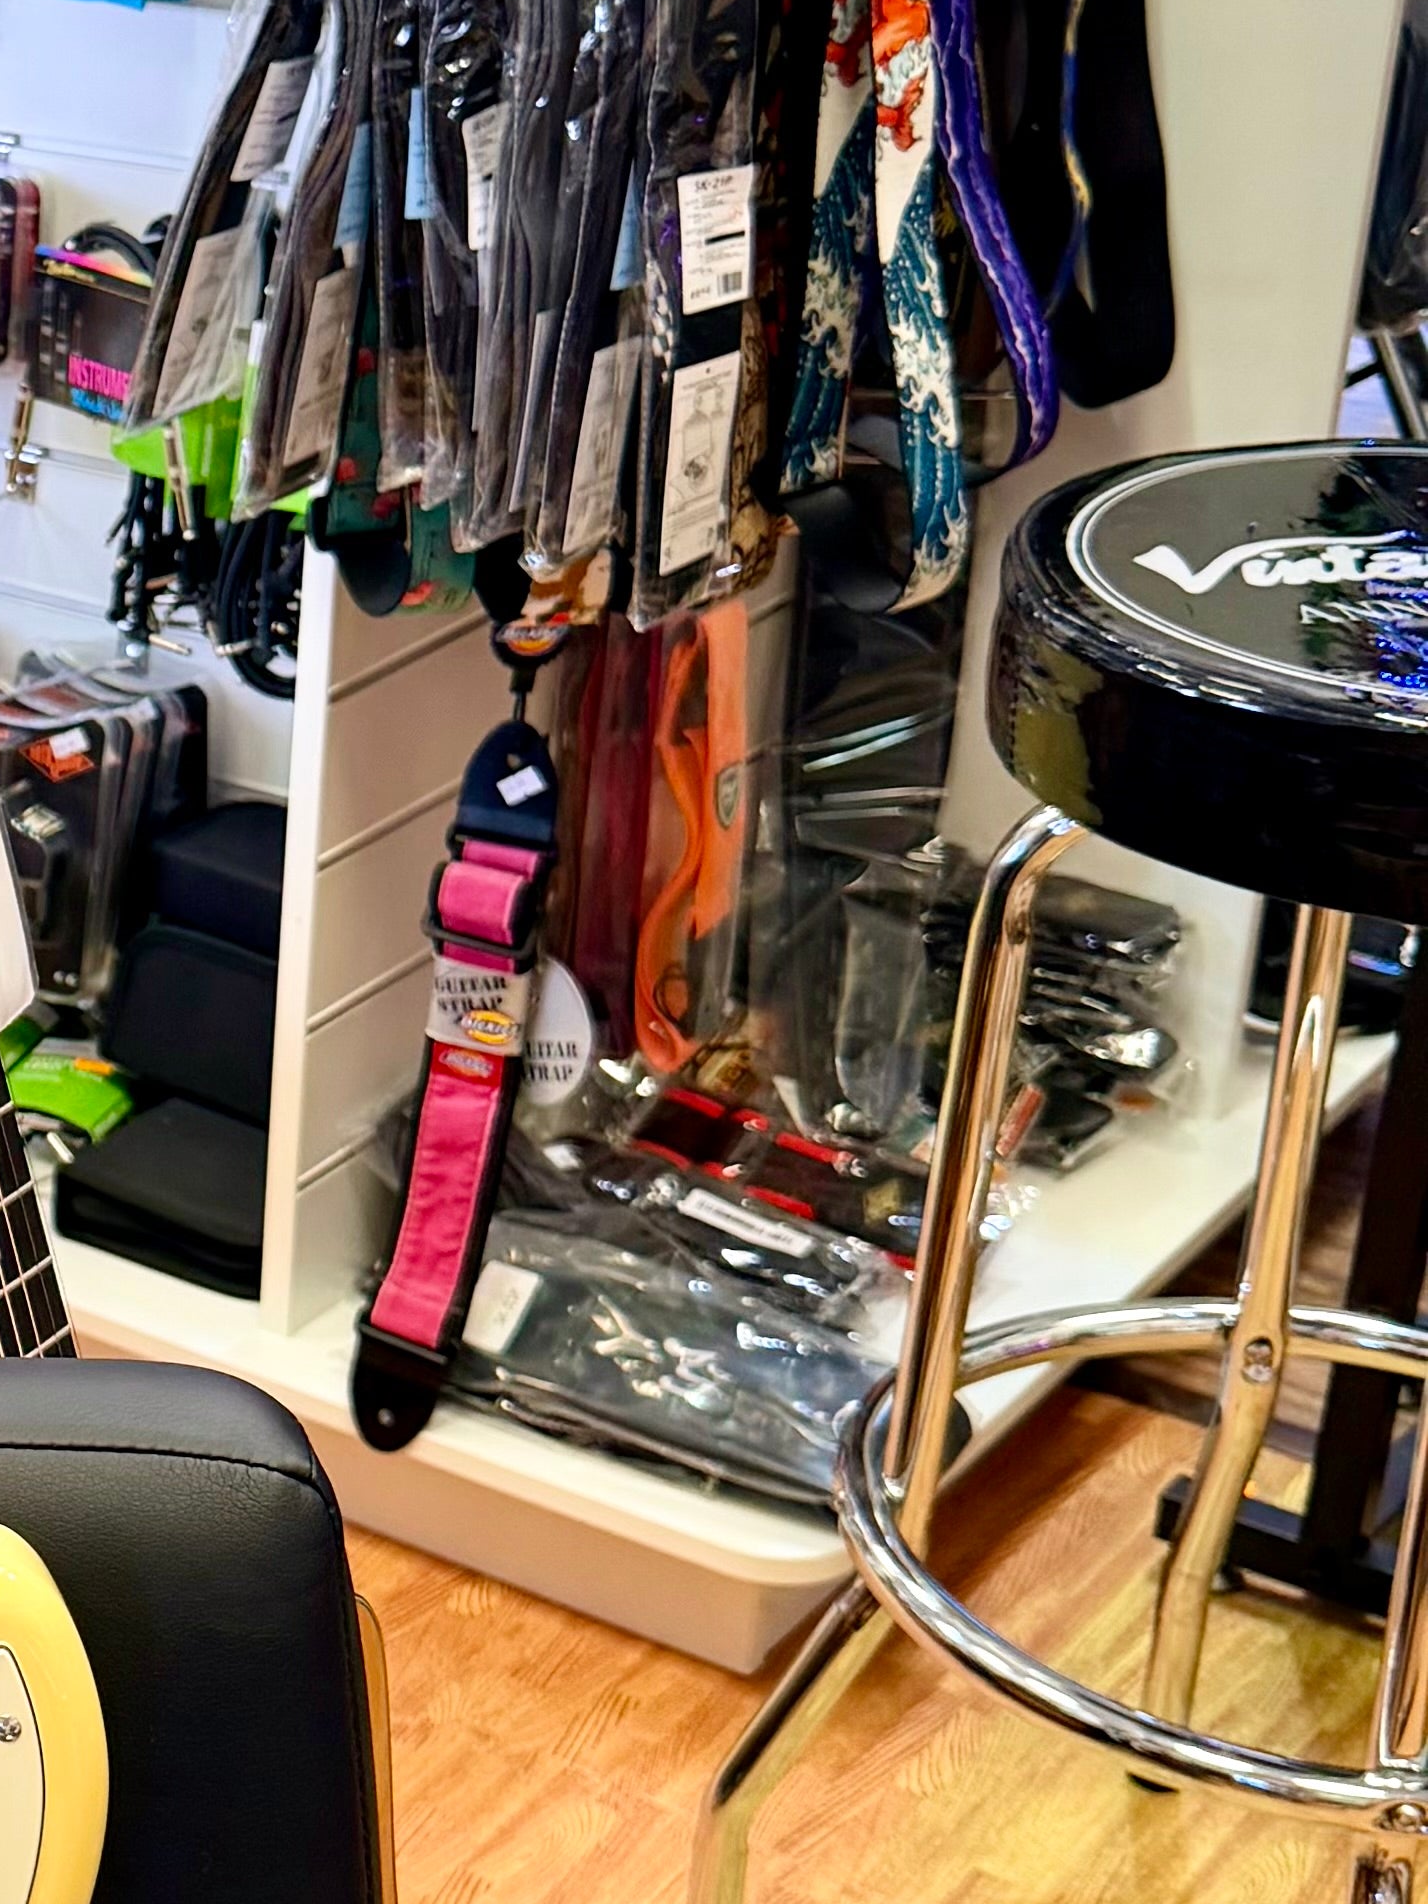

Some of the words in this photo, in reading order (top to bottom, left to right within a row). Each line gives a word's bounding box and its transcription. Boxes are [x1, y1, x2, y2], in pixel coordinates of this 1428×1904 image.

[1133, 530, 1428, 594] Vinta
[434, 975, 509, 995] GUITAR
[436, 995, 503, 1013] STRAP
[525, 1040, 579, 1059] UITAR
